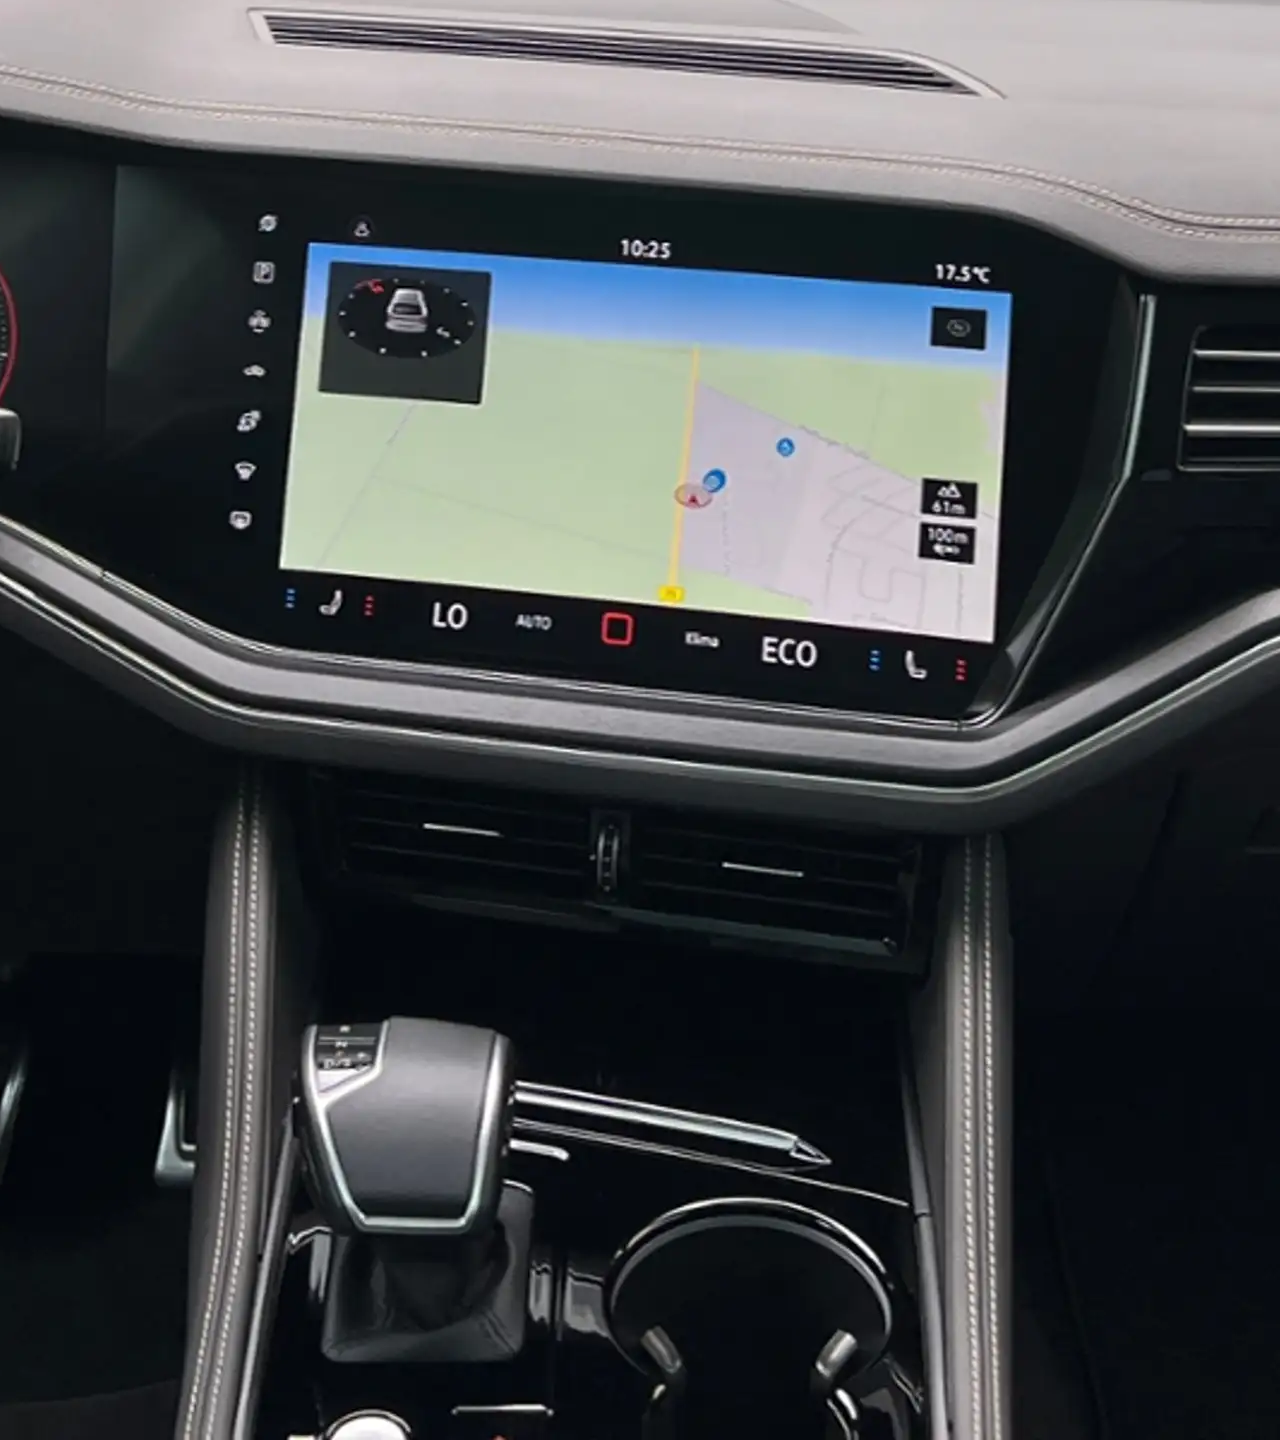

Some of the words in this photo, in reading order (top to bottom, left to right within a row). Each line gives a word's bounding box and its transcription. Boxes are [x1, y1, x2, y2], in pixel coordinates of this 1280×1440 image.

[620, 238, 672, 260] 10:25
[432, 601, 469, 630] LO
[515, 613, 553, 630] AUTO
[761, 635, 818, 668] ECO
